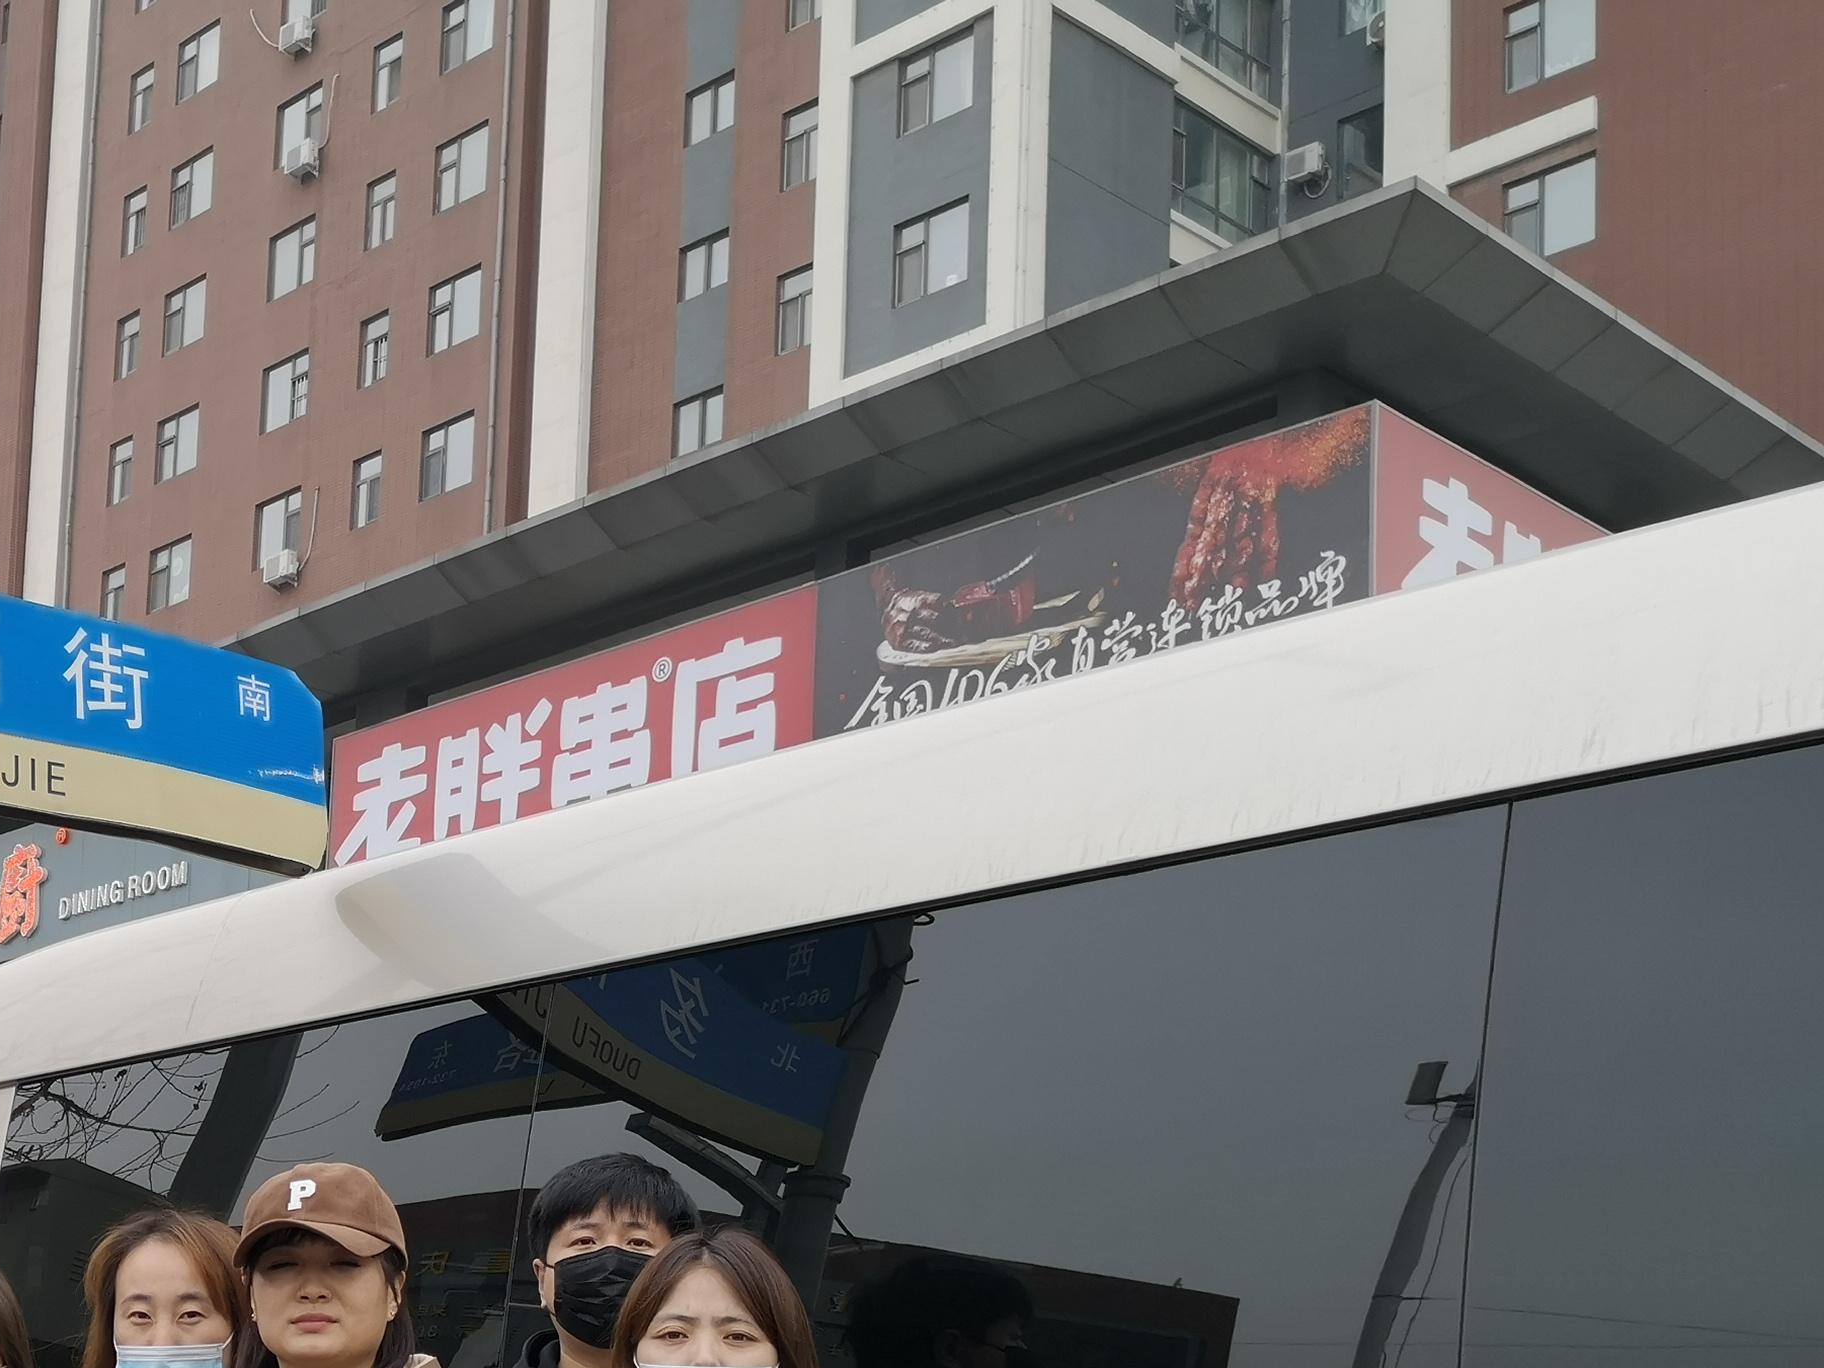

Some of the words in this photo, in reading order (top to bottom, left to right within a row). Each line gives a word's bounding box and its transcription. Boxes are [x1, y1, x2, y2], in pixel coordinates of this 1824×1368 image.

[237, 673, 272, 723] 南
[1, 753, 67, 798] JIE
[58, 880, 124, 921] DINING
[127, 860, 188, 900] ROOM
[287, 1179, 317, 1210] P
